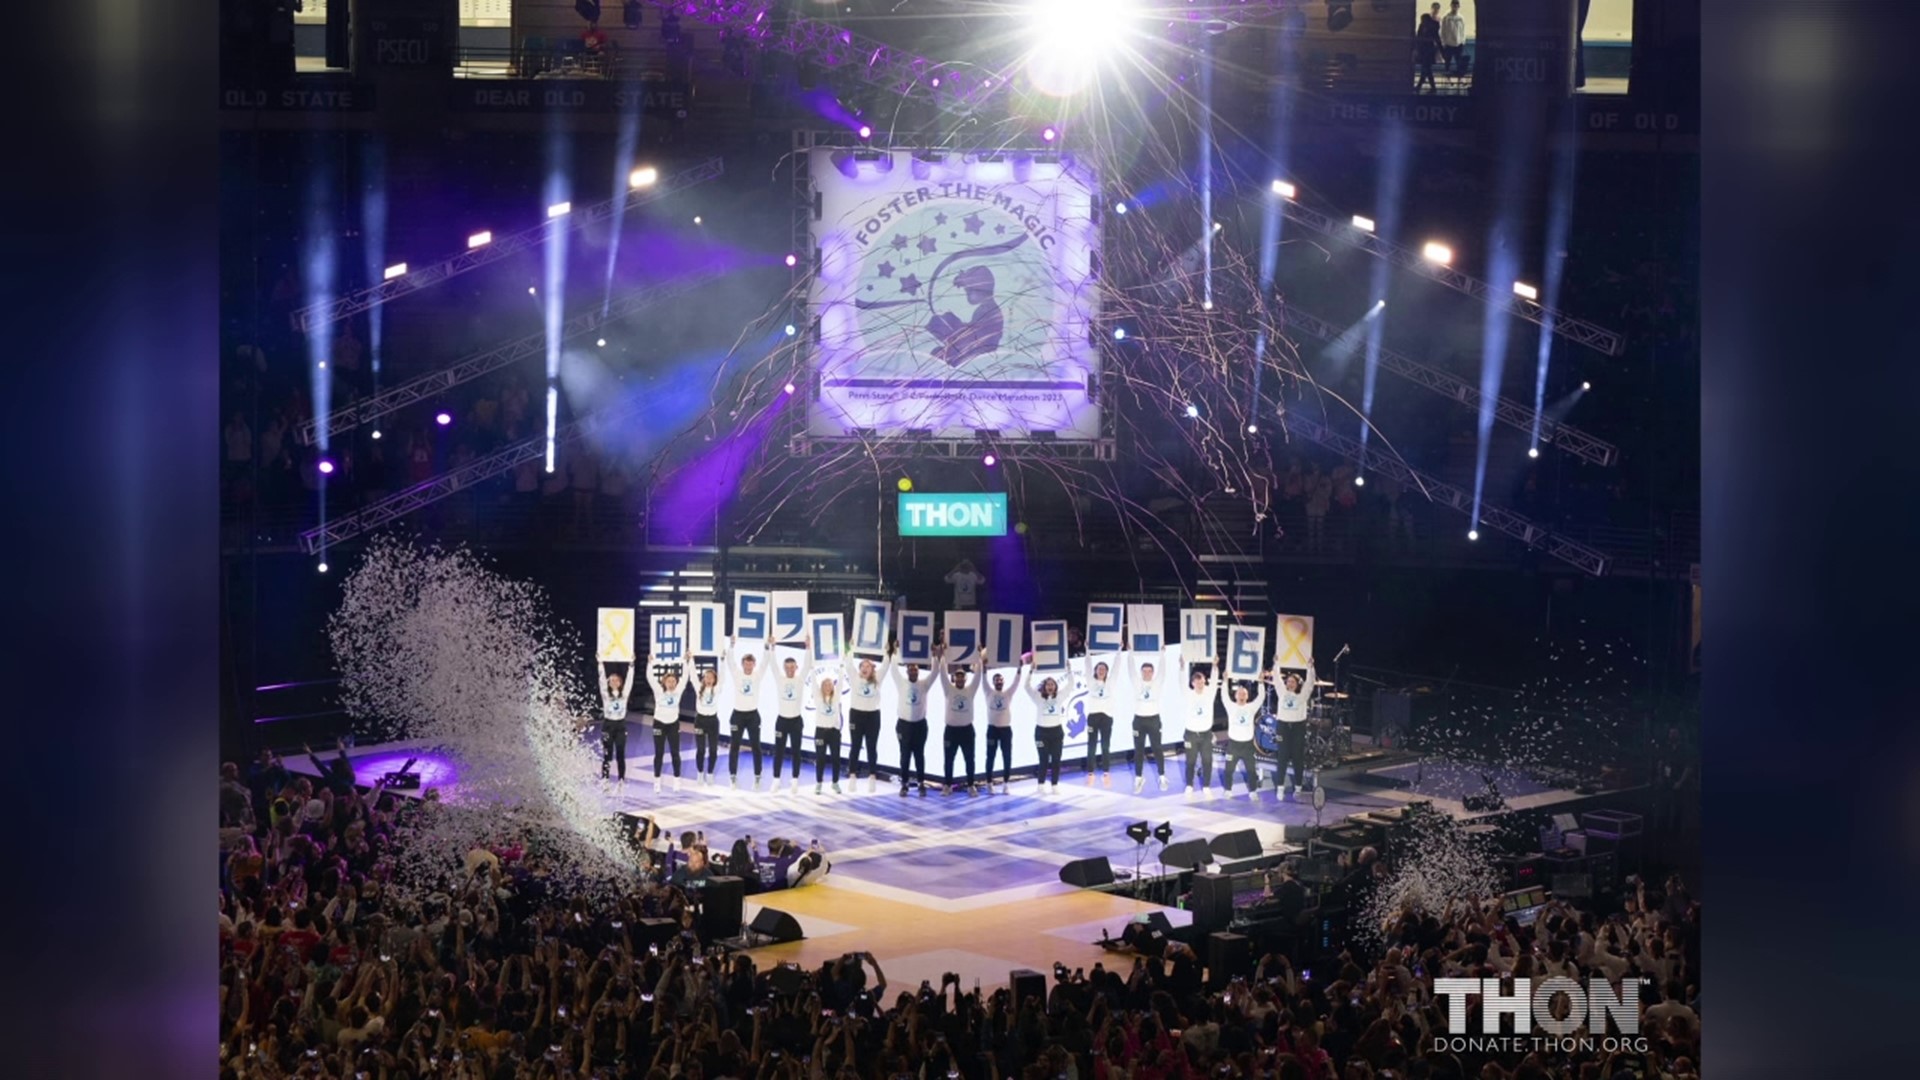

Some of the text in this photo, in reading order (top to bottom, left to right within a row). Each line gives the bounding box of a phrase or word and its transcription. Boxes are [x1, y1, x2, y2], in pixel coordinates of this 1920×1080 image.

[377, 38, 430, 64] PSECU
[1495, 56, 1546, 82] PSECU
[225, 90, 352, 107] OLD STATE
[475, 90, 685, 108] DEAR OLD STATE
[1328, 102, 1369, 119] THE
[1386, 104, 1459, 122] GLORY
[1589, 112, 1620, 129] OF
[855, 182, 1056, 250] FOSTER THE MAGIC
